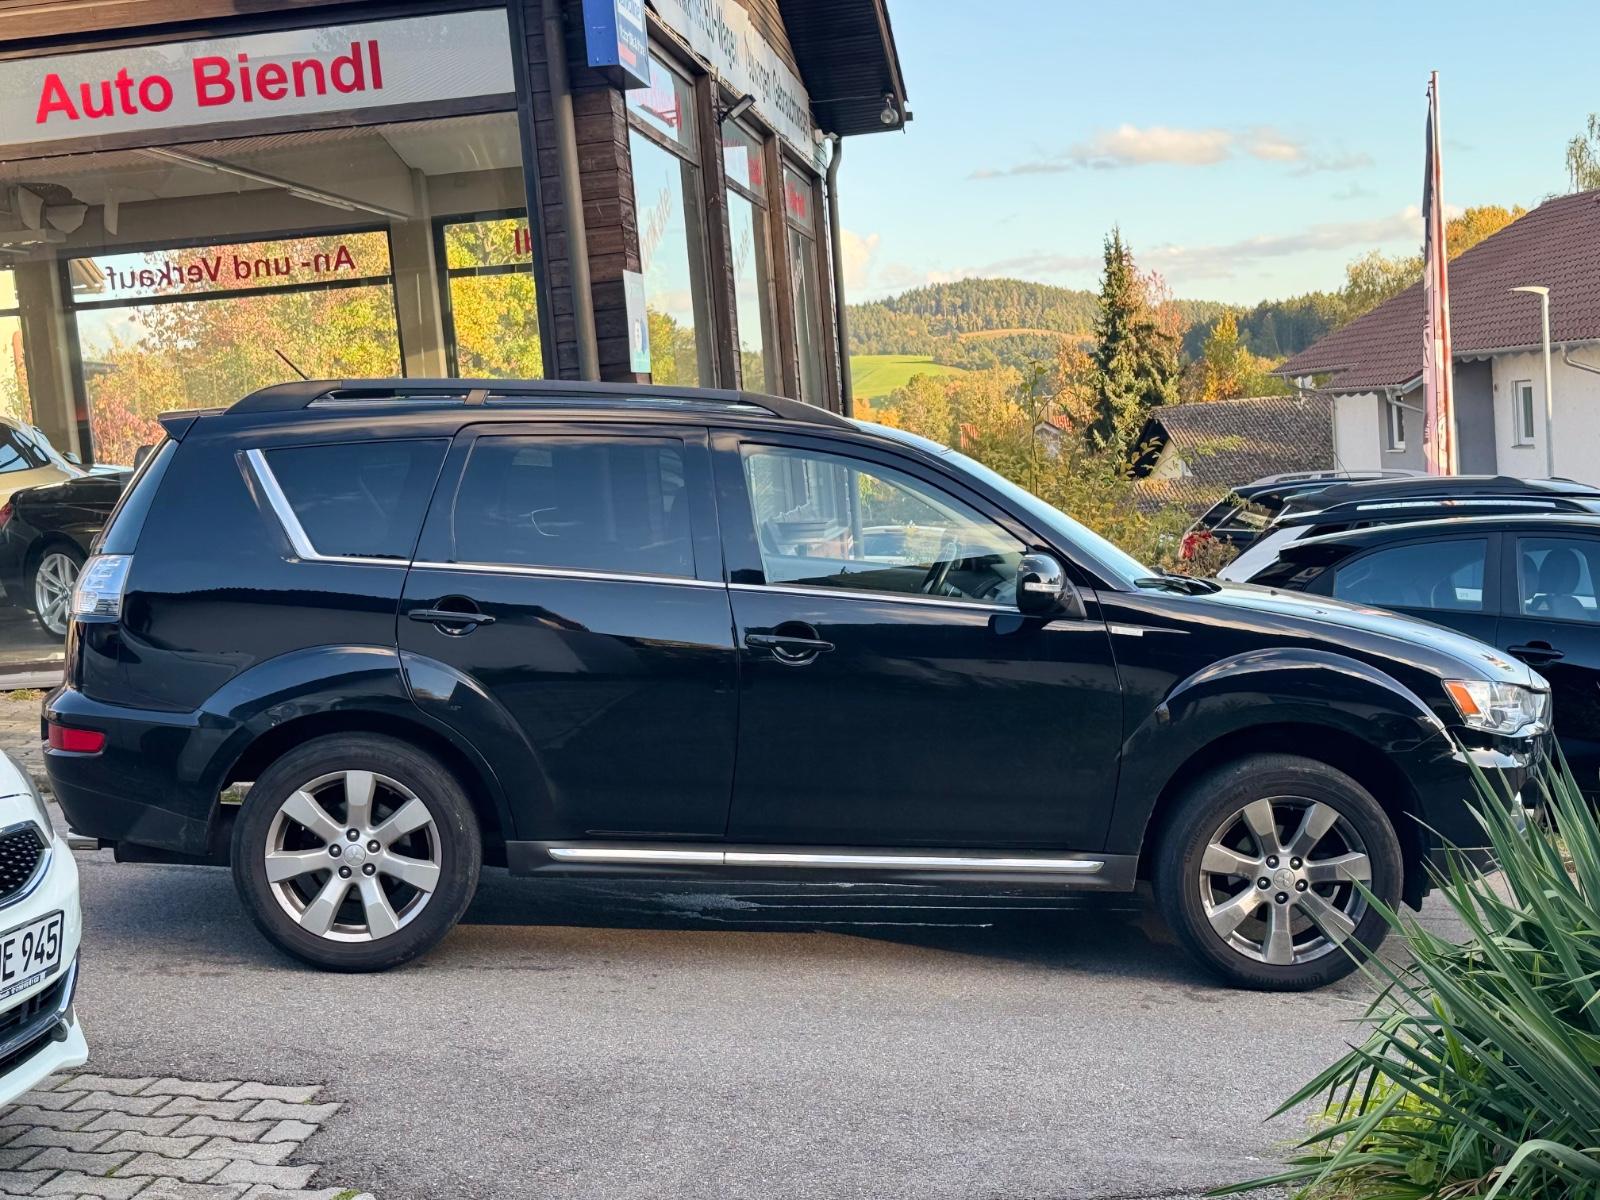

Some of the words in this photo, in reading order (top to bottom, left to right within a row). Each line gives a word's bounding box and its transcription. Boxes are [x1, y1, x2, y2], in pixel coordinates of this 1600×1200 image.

[36, 67, 174, 124] Auto
[193, 40, 383, 107] Biendl
[0, 938, 16, 981] E
[22, 919, 60, 973] 945
